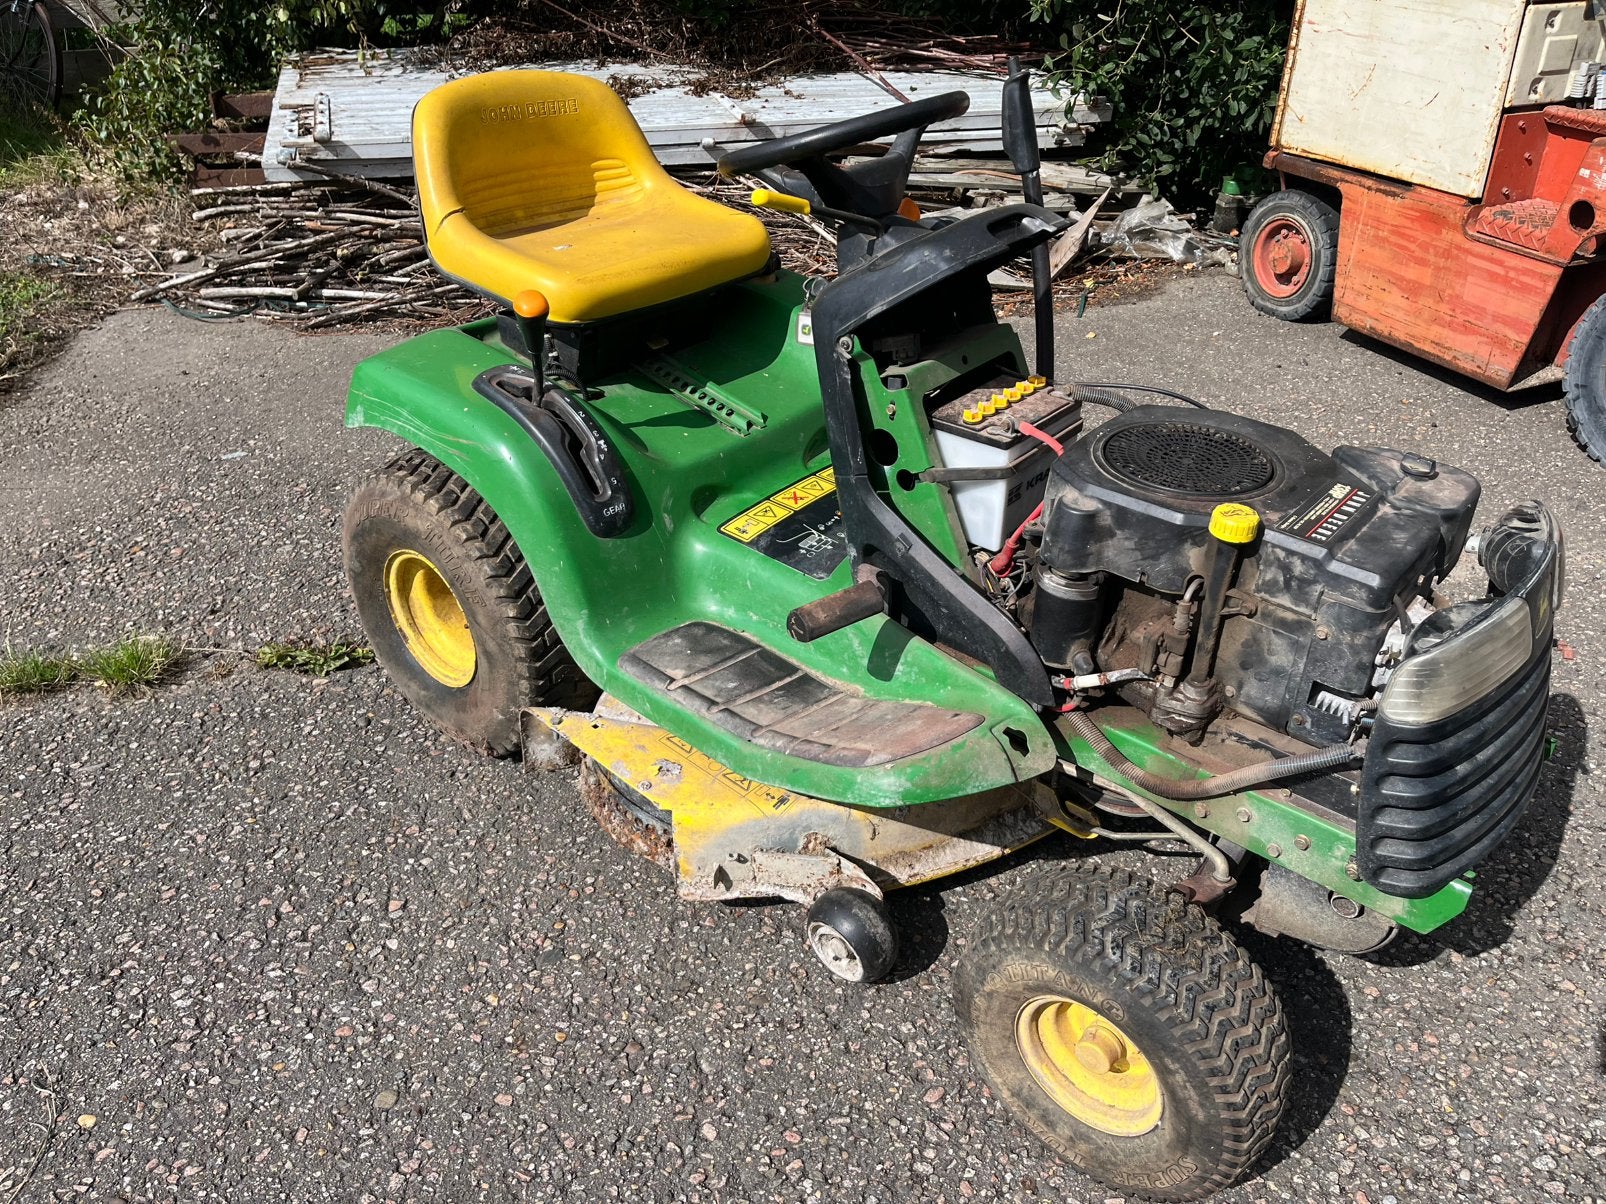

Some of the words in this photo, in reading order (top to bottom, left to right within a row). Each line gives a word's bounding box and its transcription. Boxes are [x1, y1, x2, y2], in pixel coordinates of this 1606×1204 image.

[480, 105, 521, 125] JOHN
[525, 98, 579, 118] DEERE
[1339, 491, 1370, 513] JOHN
[1311, 512, 1349, 541] DEERE
[1003, 961, 1101, 1001] TITAN
[1110, 1155, 1199, 1190] SUPER
